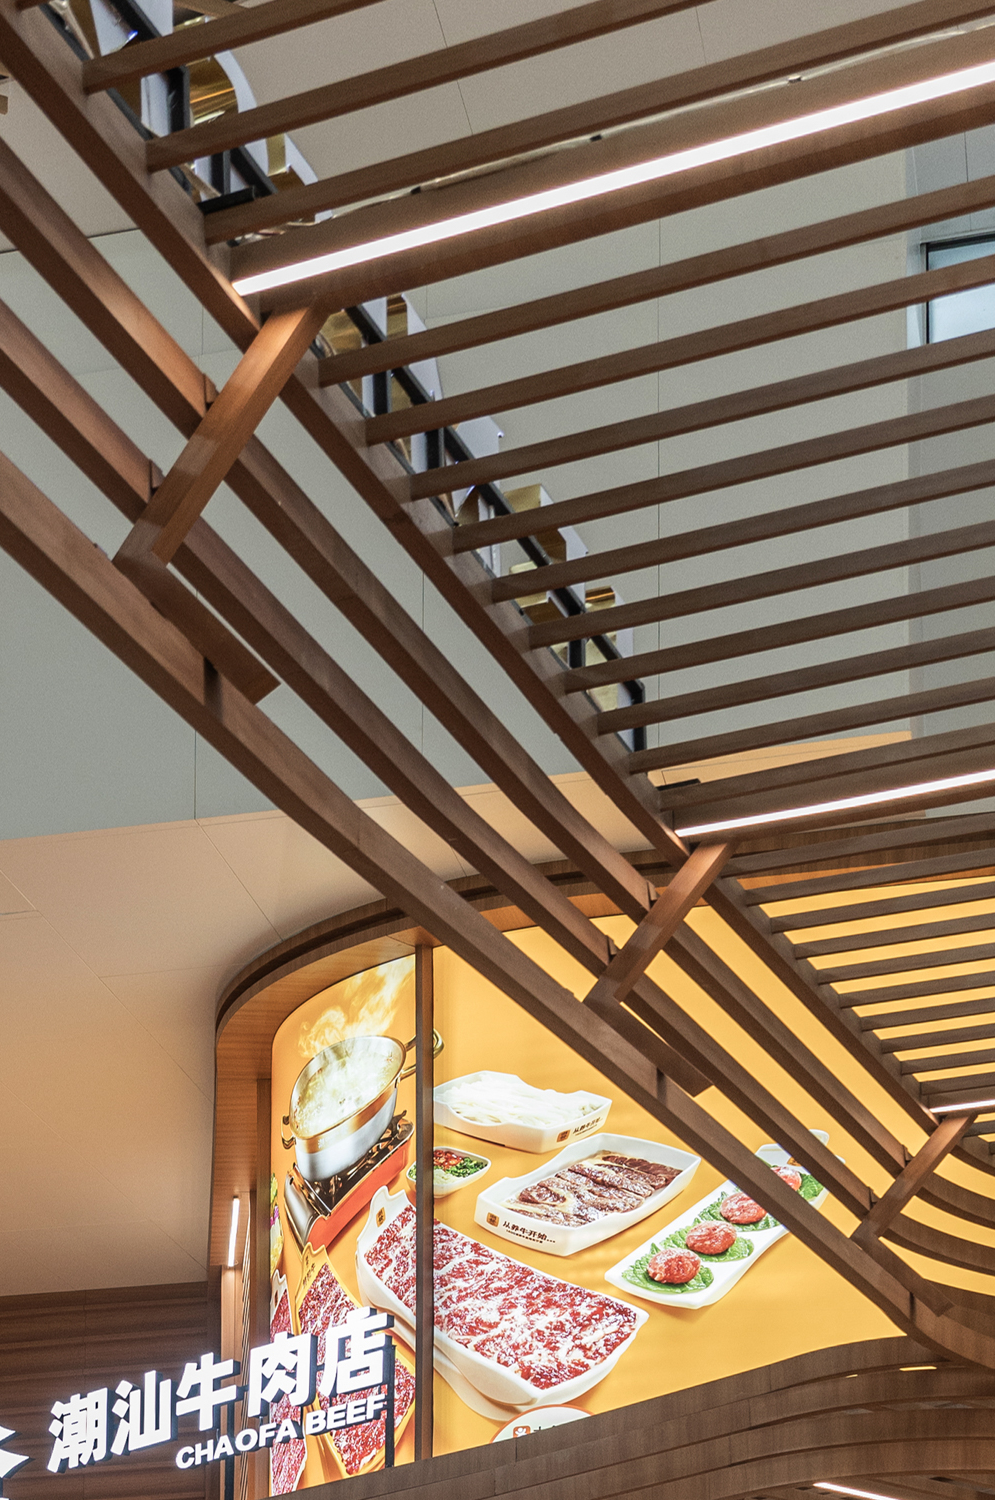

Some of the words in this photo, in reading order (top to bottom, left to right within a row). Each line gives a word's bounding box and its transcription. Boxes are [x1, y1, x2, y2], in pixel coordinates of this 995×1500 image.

[47, 1306, 390, 1473] 潮汕牛肉店
[175, 1418, 299, 1470] CHAOFA
[303, 1394, 387, 1435] BEEF
